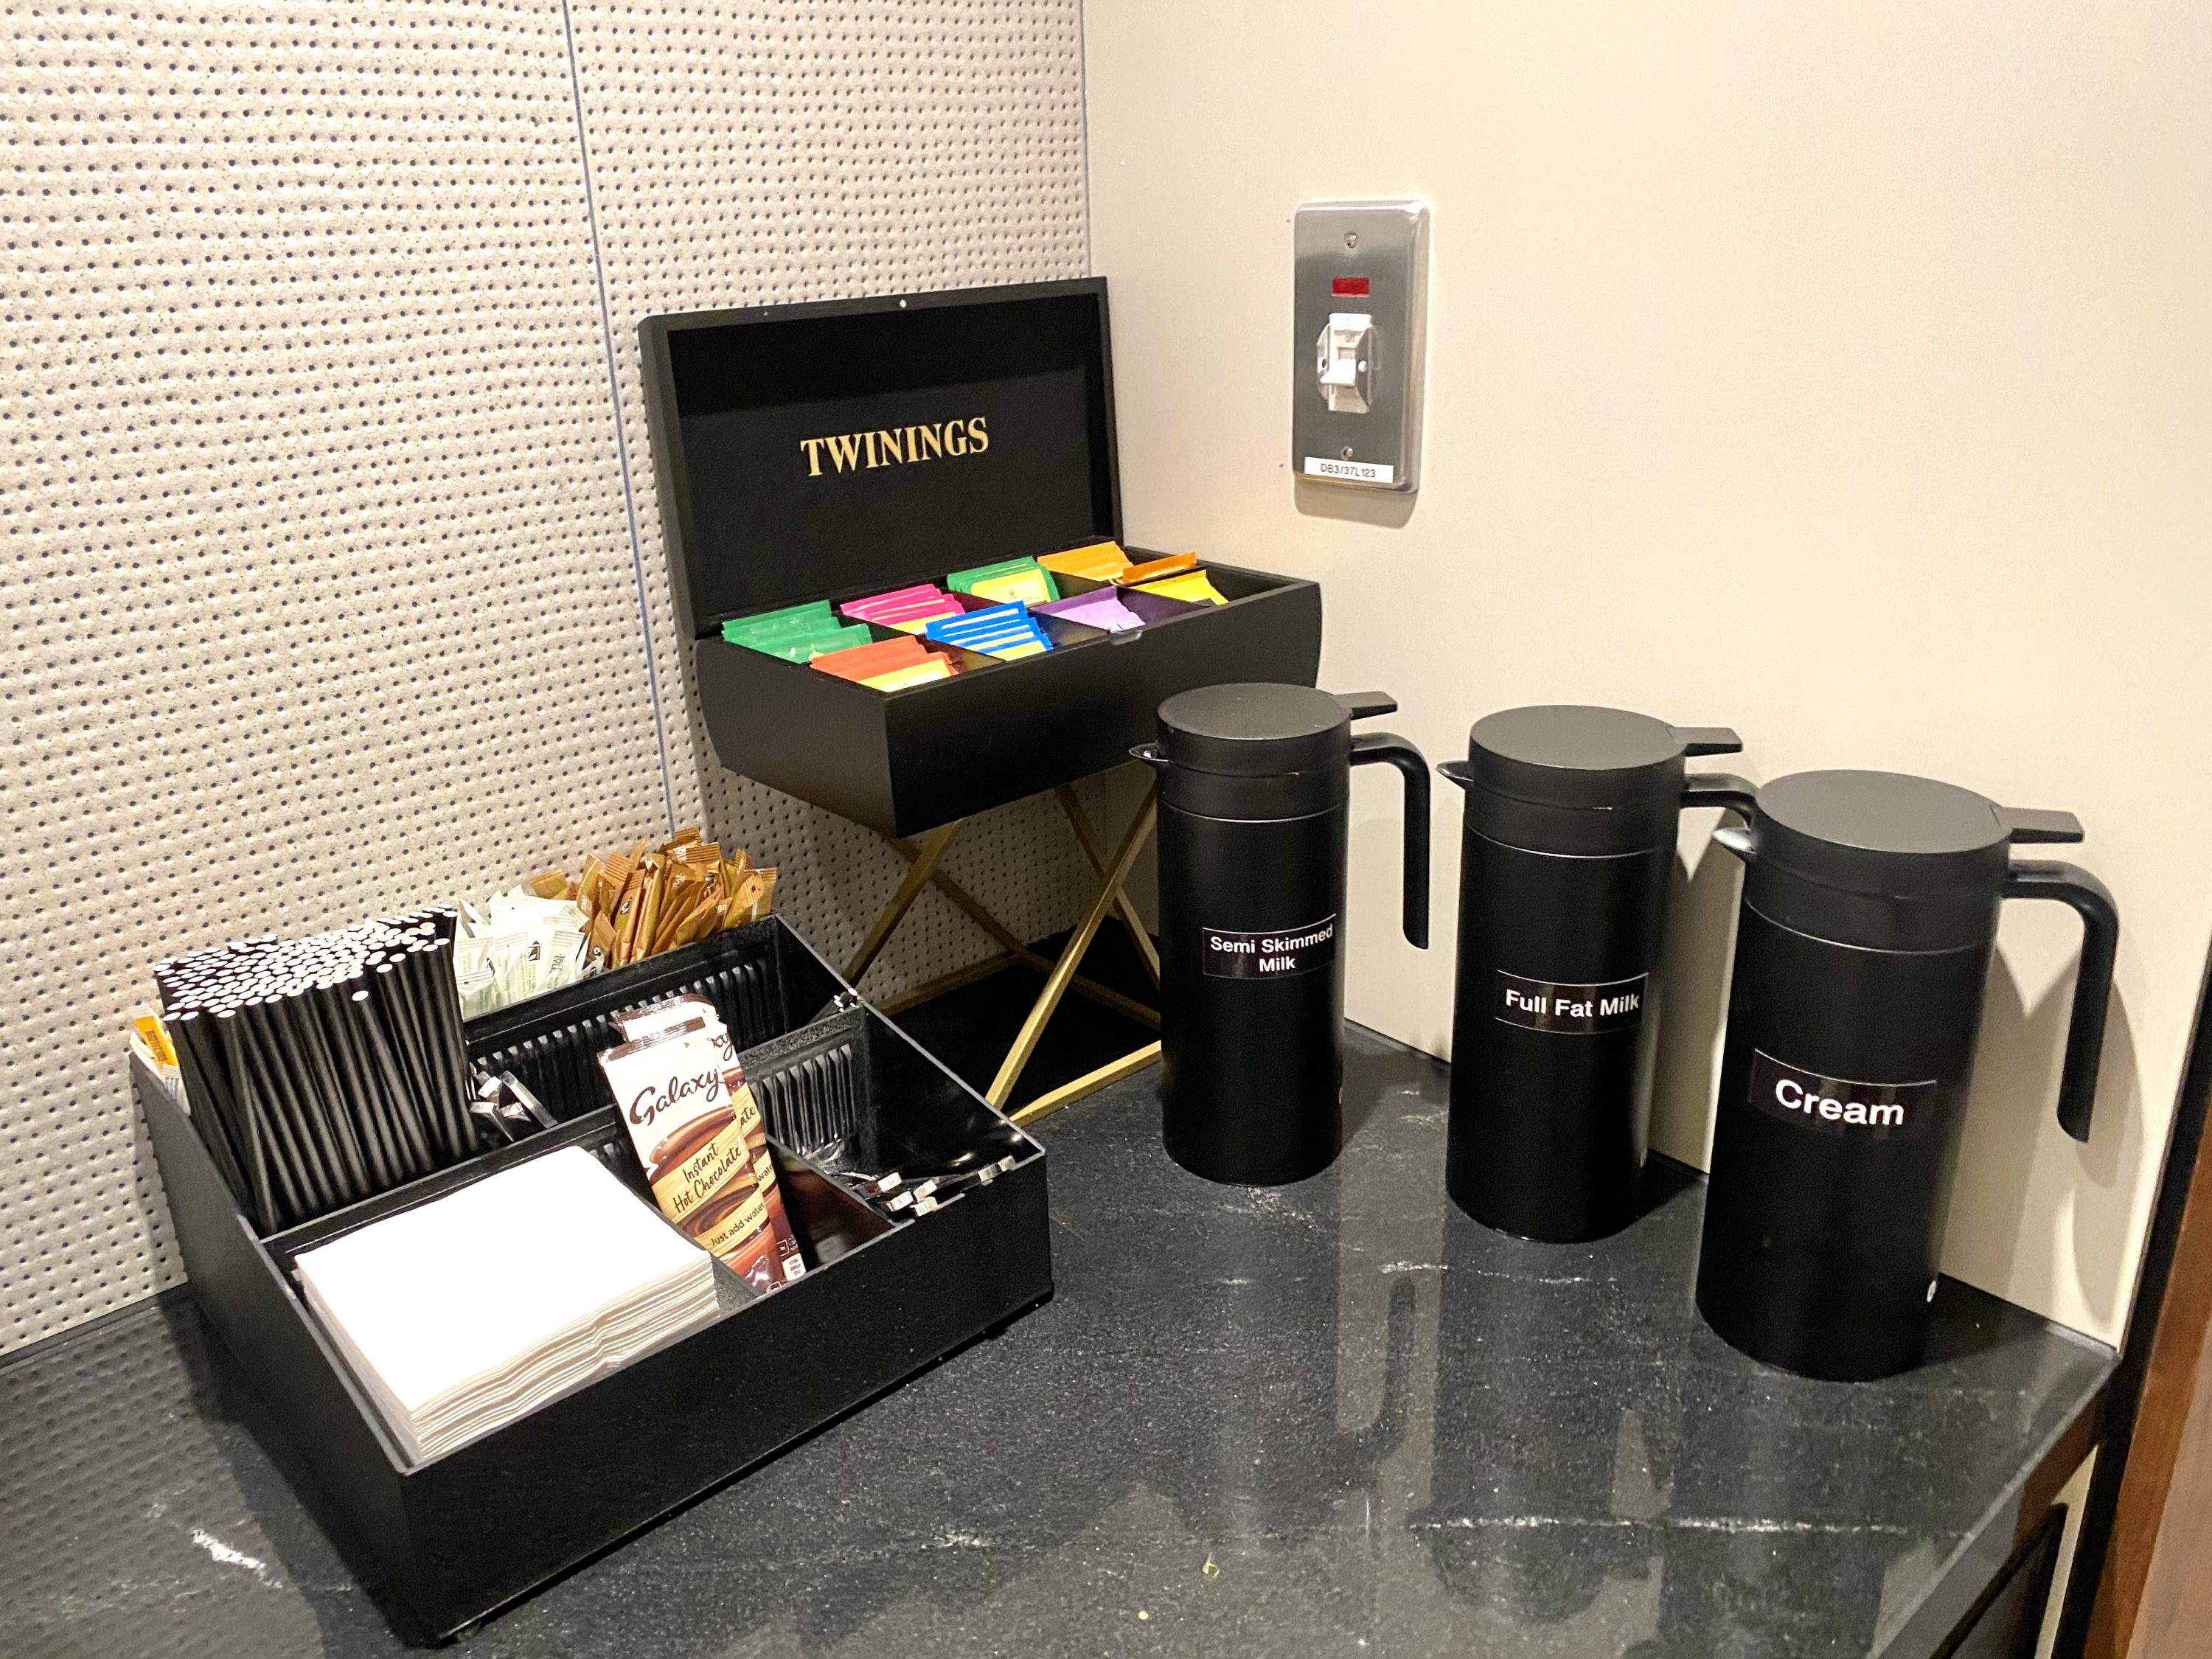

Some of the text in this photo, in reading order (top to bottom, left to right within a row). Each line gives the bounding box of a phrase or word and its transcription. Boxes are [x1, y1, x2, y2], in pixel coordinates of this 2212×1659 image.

[800, 417, 989, 476] TWININGS
[1320, 463, 1377, 478] DB3/37L123
[1210, 923, 1333, 953] Semi Skimmed
[1259, 956, 1295, 972] Milk
[1506, 989, 1640, 1018] Full Fat Milk
[629, 1068, 726, 1126] Galaxy
[1775, 1079, 1905, 1126] Cream
[672, 1147, 742, 1213] Hot Chocolate
[682, 1142, 719, 1183] Instant
[710, 1202, 765, 1246] Just add water
